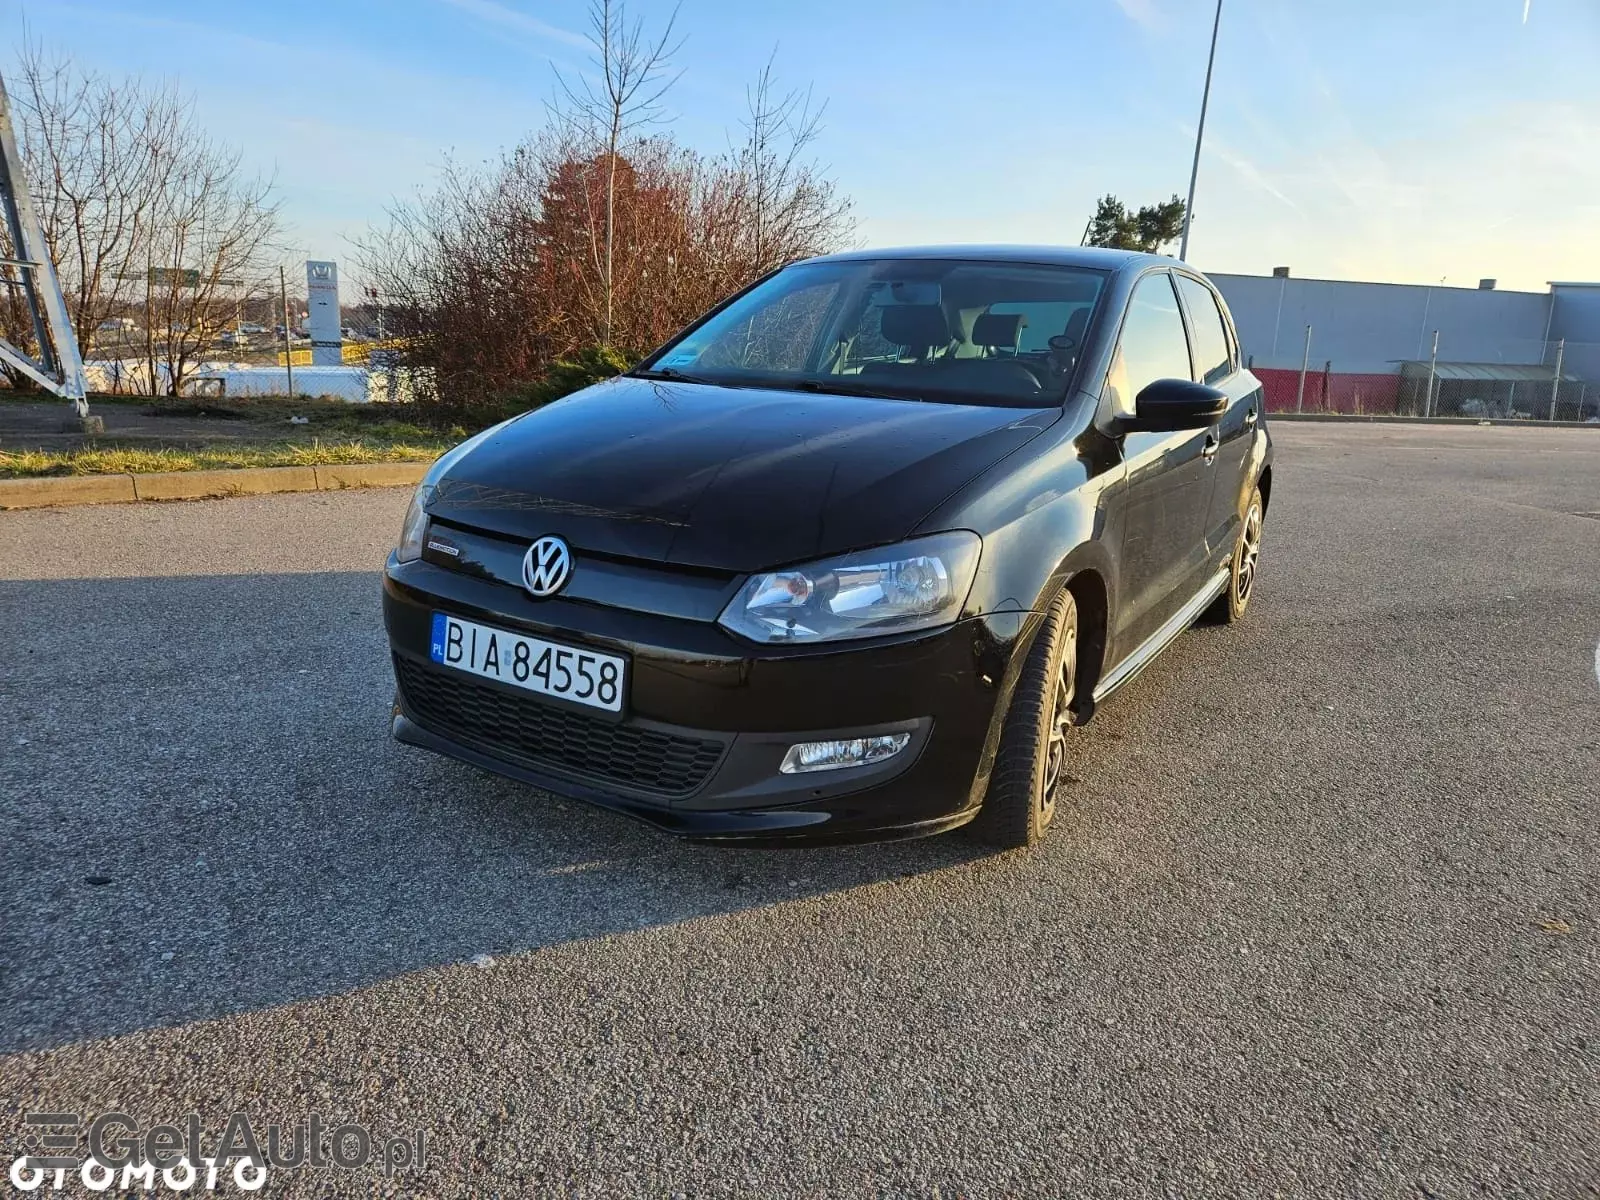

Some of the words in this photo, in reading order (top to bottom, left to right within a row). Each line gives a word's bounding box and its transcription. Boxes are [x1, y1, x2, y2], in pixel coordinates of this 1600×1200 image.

[522, 536, 570, 596] VW
[432, 643, 443, 656] PL
[446, 622, 500, 676] BIA
[512, 641, 618, 704] 84558
